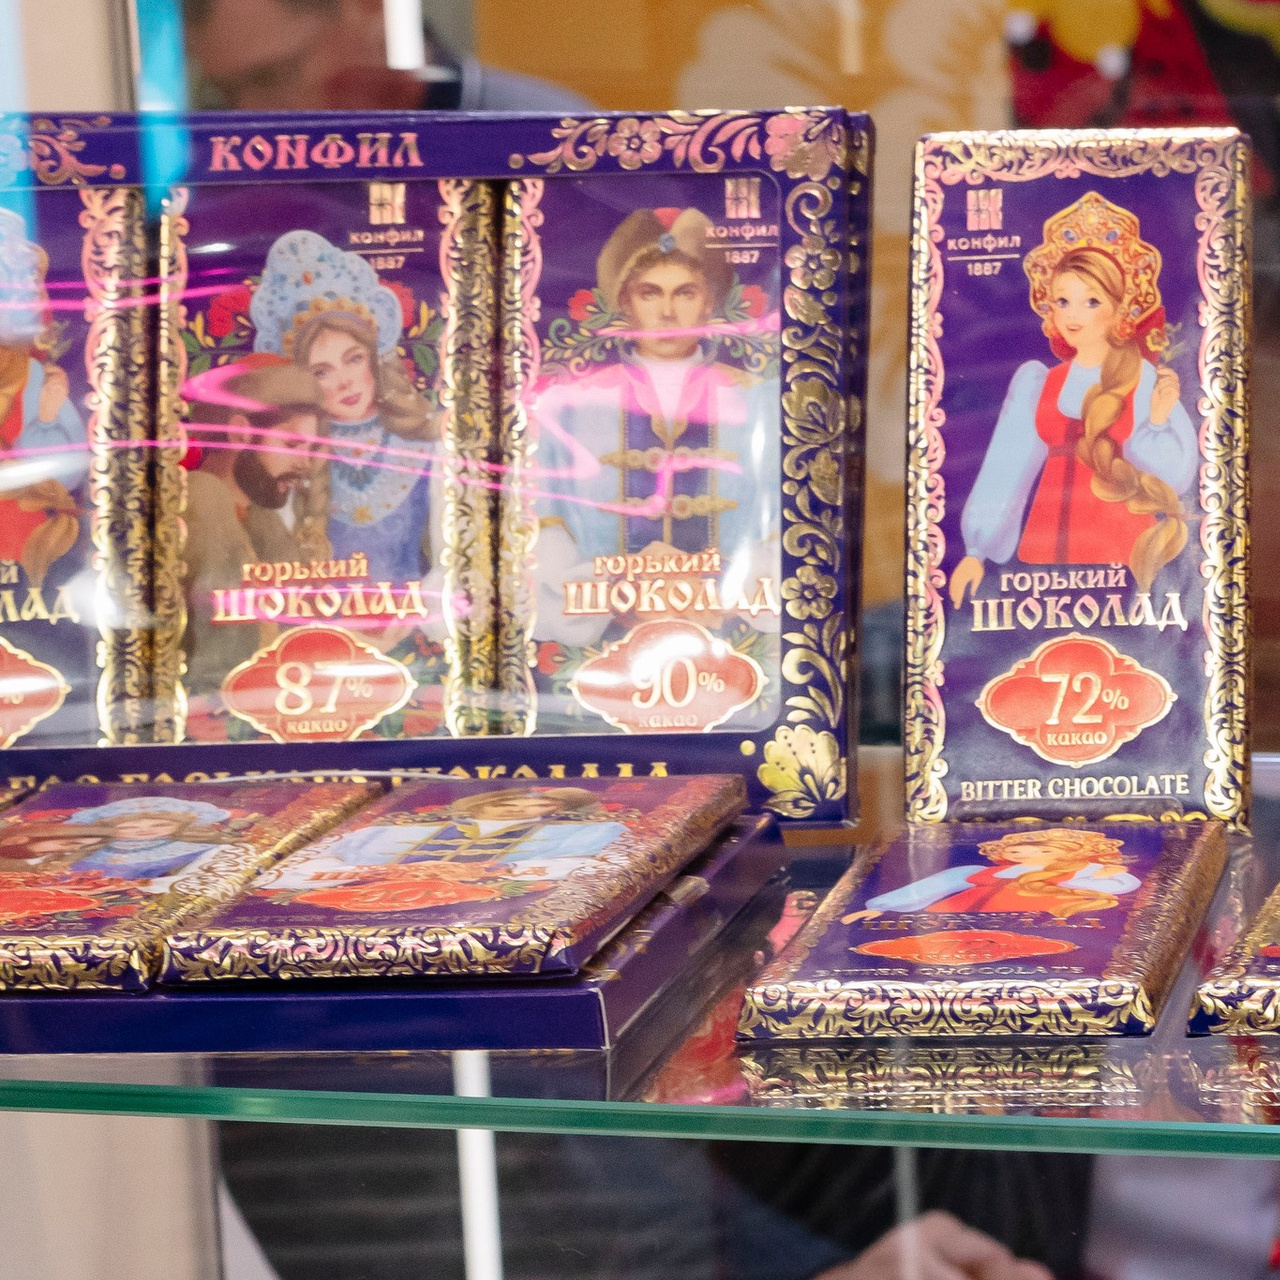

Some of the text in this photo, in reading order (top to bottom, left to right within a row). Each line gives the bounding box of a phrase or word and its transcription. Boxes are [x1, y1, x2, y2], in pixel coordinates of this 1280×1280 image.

[209, 132, 424, 171] КОНФИЛ
[705, 224, 779, 241] конфил
[947, 234, 1021, 253] конфил
[724, 250, 760, 264] 1887
[966, 262, 1002, 276] 1887
[242, 552, 370, 582] горький
[594, 549, 721, 580] горький
[1001, 562, 1127, 598] горький
[211, 581, 430, 622] ШОКОЛАД
[970, 592, 1188, 631] ШОКОЛАД
[1041, 671, 1129, 725] 72%
[1046, 731, 1108, 746] какао
[960, 774, 1190, 802] BITTER CHOCOLATE
